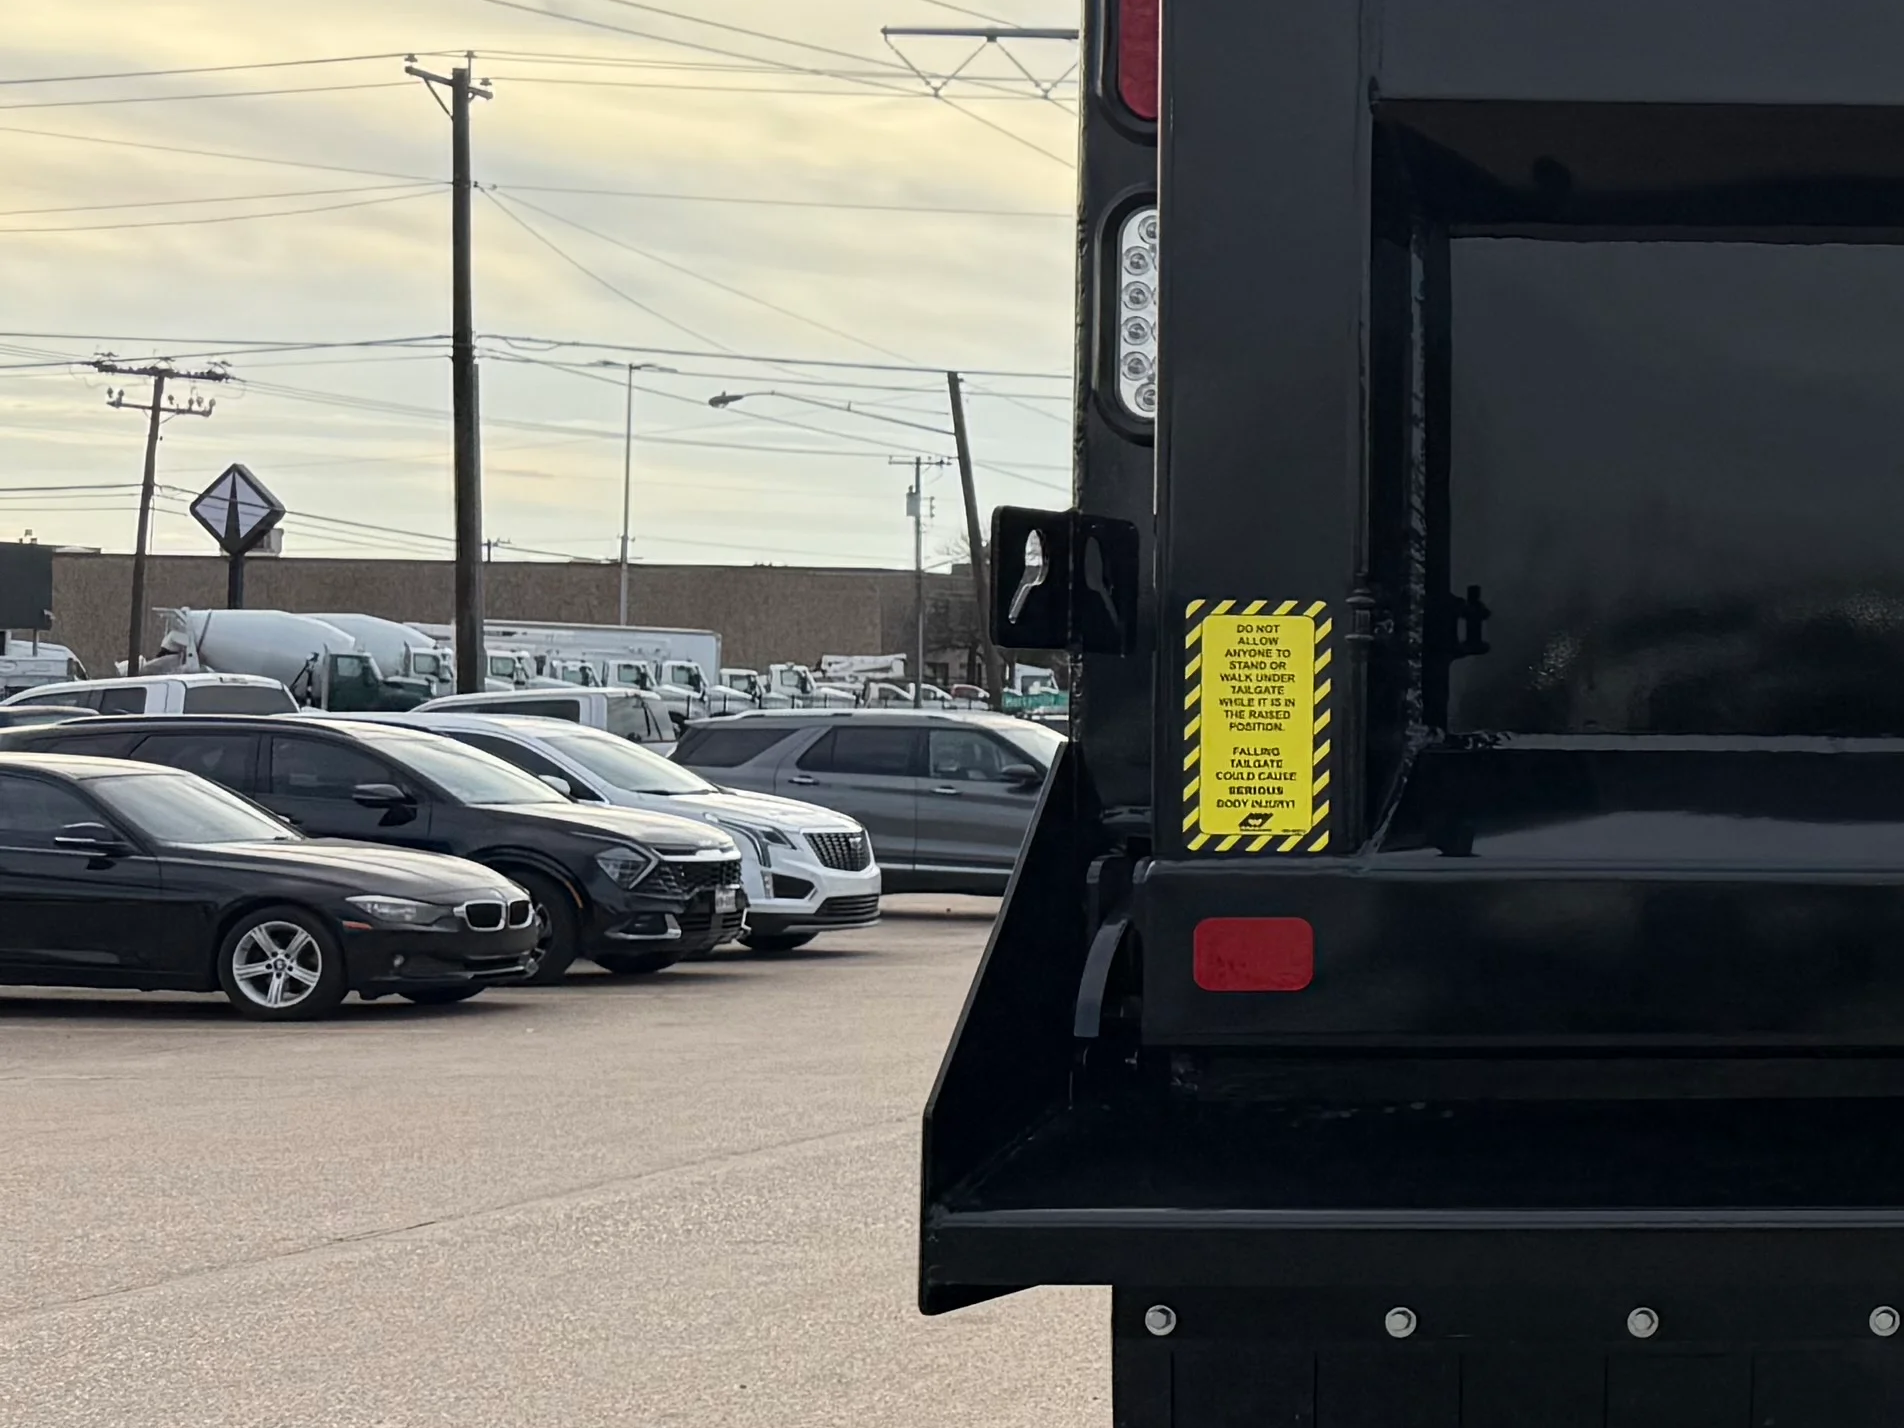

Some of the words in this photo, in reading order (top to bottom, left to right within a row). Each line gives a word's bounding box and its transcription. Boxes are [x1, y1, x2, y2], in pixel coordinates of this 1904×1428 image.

[1236, 624, 1254, 634] DO
[1255, 624, 1281, 634] NOT
[1237, 636, 1280, 646] ALLOW
[1224, 648, 1273, 659] ANYONE
[1275, 648, 1292, 659] TO
[1229, 660, 1267, 671] STAND
[1269, 660, 1287, 671] OR
[1219, 672, 1253, 683] WALK
[1255, 672, 1296, 683] UNDER
[1230, 685, 1285, 696] TAILGATE
[1218, 697, 1255, 708] WHILE
[1257, 697, 1268, 708] IT
[1270, 697, 1282, 708] IS
[1284, 697, 1296, 708] IN
[1223, 709, 1246, 720] THE
[1248, 709, 1291, 720] RAISED
[1232, 746, 1281, 757] FALLING
[1230, 758, 1284, 769] TAILGATE
[1215, 770, 1256, 782] COULD
[1228, 785, 1284, 796] SERIOUS
[1215, 798, 1249, 809] BODY
